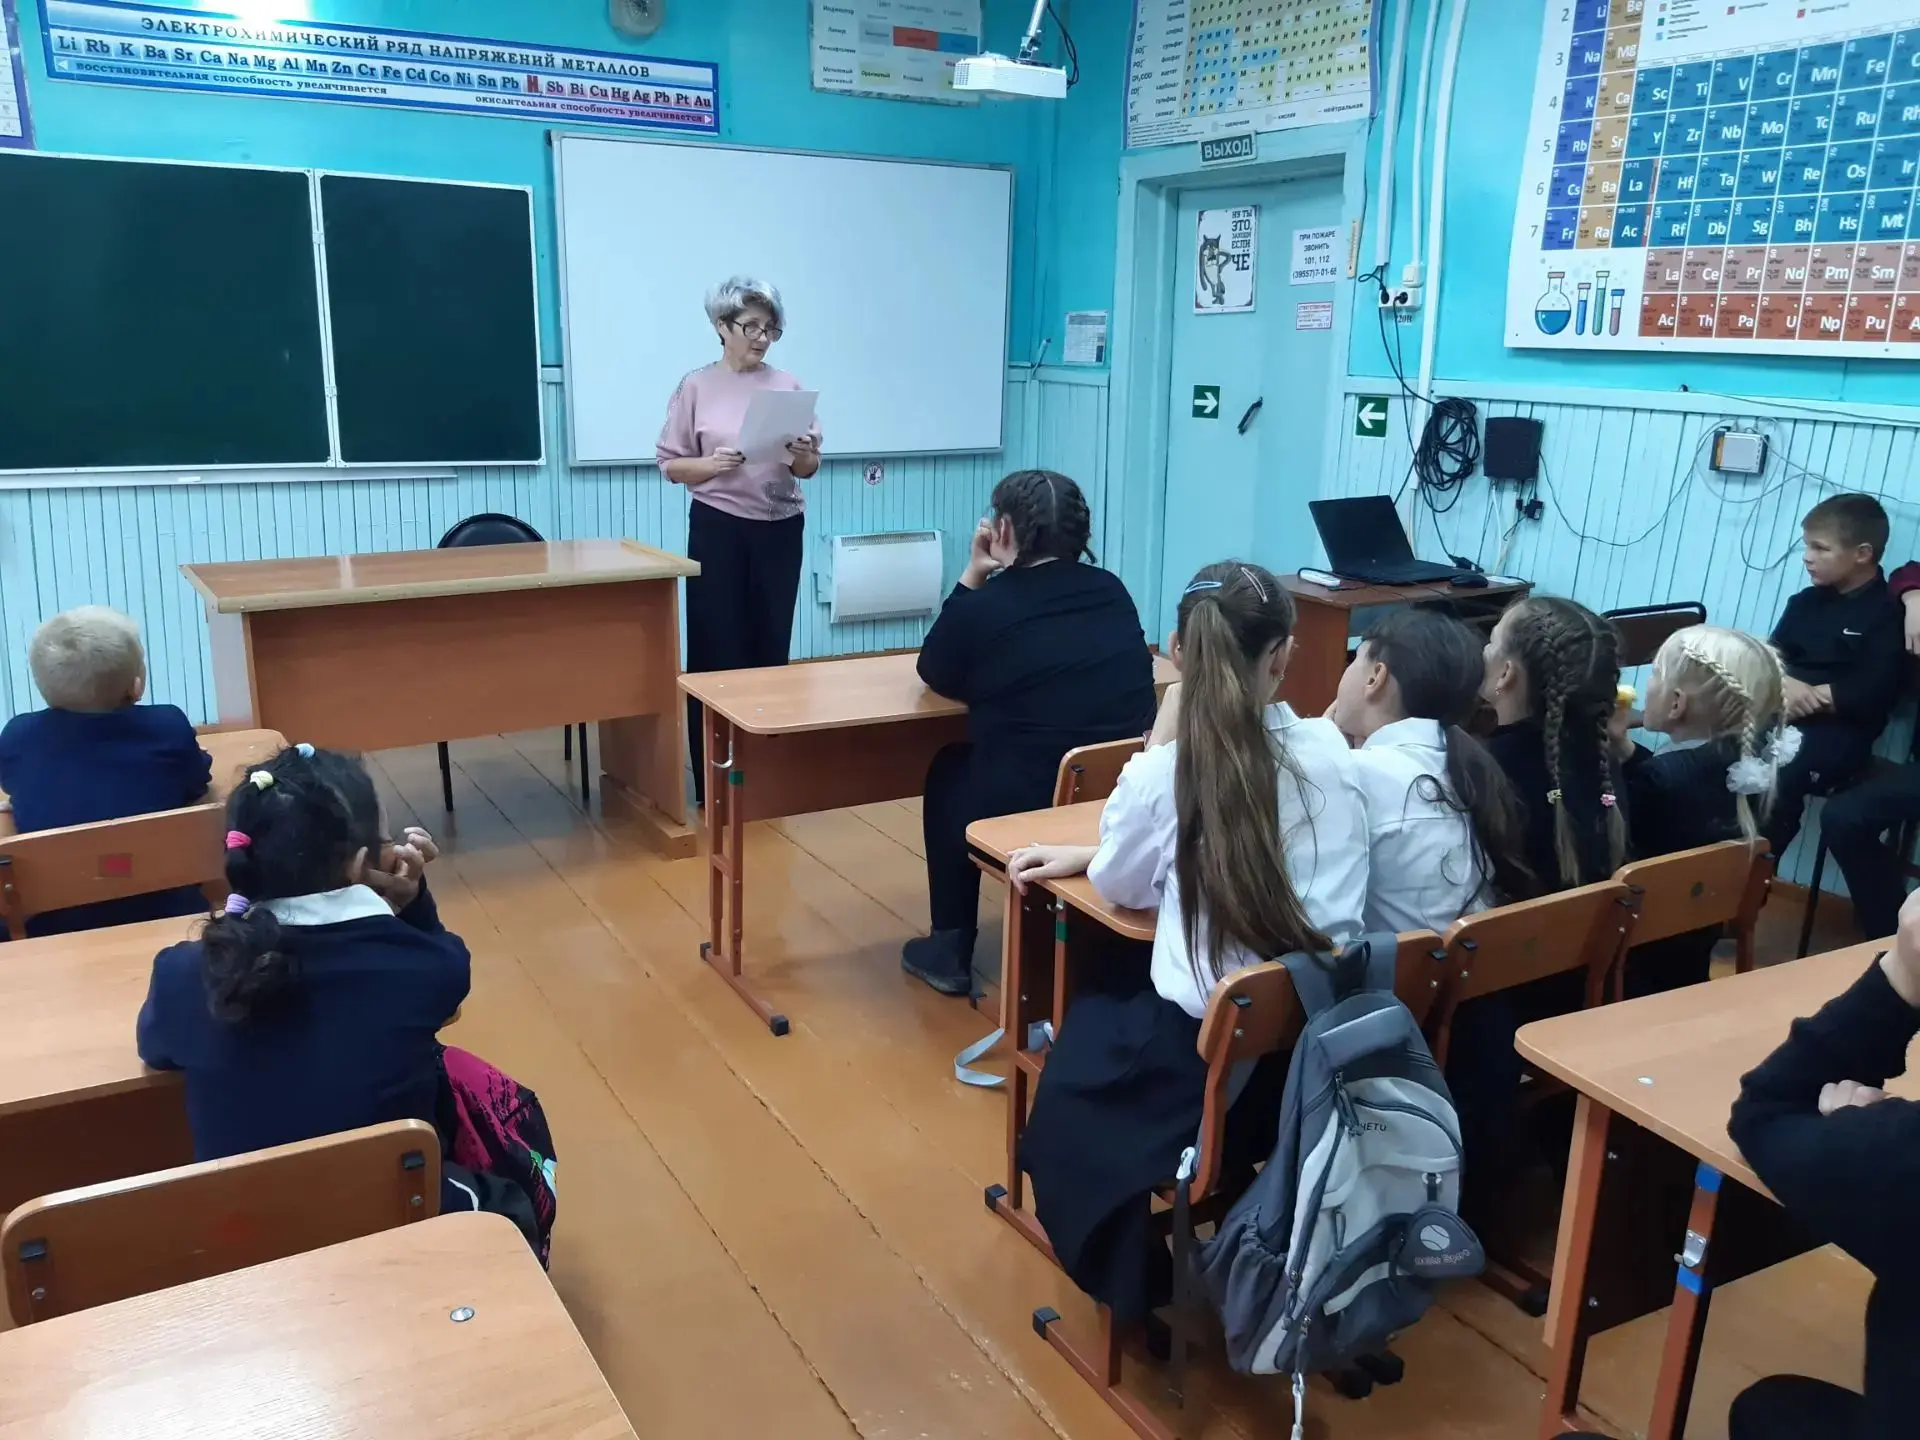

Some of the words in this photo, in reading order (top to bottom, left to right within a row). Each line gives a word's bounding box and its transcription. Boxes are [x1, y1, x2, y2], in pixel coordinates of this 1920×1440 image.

[1597, 5, 1607, 18] Li
[1627, 0, 1642, 13] Be
[1561, 8, 1570, 21] 2
[141, 17, 379, 51] ЭЛЕКТРОХИМИЧЕСКИЙ
[386, 40, 423, 56] РЯД
[429, 45, 555, 69] НАПРЯЖЕНИЙ
[562, 58, 650, 78] МЕТАЛЛОВ
[1555, 52, 1563, 66] 3
[1584, 51, 1600, 63] Na
[58, 36, 77, 50] Li
[85, 39, 110, 54] Rb
[120, 43, 135, 56] K
[144, 45, 168, 60] Ba
[174, 48, 193, 61] Sr
[200, 50, 222, 64] Ca
[227, 52, 249, 66] Na
[253, 55, 277, 71] Mg
[283, 58, 299, 70] Al
[305, 59, 328, 73] Mn
[332, 61, 353, 74] Zn
[357, 63, 377, 77] Cr
[382, 65, 401, 78] Fe
[406, 68, 427, 81] Cd
[430, 70, 450, 83] Co
[456, 72, 472, 85] Ni
[478, 75, 496, 88] Sn
[502, 76, 519, 89] Pb
[546, 81, 564, 94] Sb
[570, 83, 584, 96] Bi
[590, 85, 608, 98] Cu
[611, 87, 630, 102] Hg
[633, 91, 650, 106] Ag
[654, 91, 670, 104] Pb
[676, 93, 689, 106] Pt
[694, 96, 711, 108] Au
[1866, 59, 1885, 74] Fe
[75, 62, 209, 81] восстановительная
[213, 74, 293, 87] способность
[297, 80, 388, 95] увеличивается
[1776, 72, 1792, 85] Cr
[1811, 67, 1837, 82] Mn
[1696, 83, 1708, 96] Ti
[1739, 77, 1749, 90] V
[1615, 92, 1630, 104] Ca
[1652, 87, 1668, 100] Sc
[475, 96, 557, 109] окислительная
[560, 102, 625, 116] способность
[1549, 96, 1557, 108] 4
[1586, 95, 1594, 108] K
[1815, 116, 1829, 129] Tc
[1856, 112, 1876, 126] Ru
[1721, 126, 1741, 139] Nb
[1761, 122, 1783, 134] Mo
[1653, 132, 1662, 144] Y
[1686, 128, 1700, 142] Zr
[1204, 138, 1251, 159] ВЫХОД
[1543, 139, 1550, 152] 5
[1572, 139, 1587, 152] Rb
[1611, 136, 1624, 148] Sr
[1847, 165, 1866, 178] Os
[1902, 160, 1916, 174] Ir
[1719, 173, 1734, 186] Ta
[1761, 171, 1776, 183] W
[1803, 168, 1820, 180] Re
[1536, 182, 1544, 195] 6
[1602, 181, 1616, 193] Ba
[1629, 180, 1643, 192] La
[1677, 176, 1694, 190] Hf
[1567, 184, 1580, 196] Cs
[1752, 220, 1768, 235] Sg
[1795, 218, 1812, 231] Bh
[1839, 217, 1857, 230] Hs
[1881, 214, 1905, 228] Mt
[1531, 225, 1538, 238] 7
[1562, 228, 1574, 240] Fr
[1594, 227, 1610, 238] Ra
[1621, 225, 1637, 238] Ac
[1671, 223, 1686, 236] Rf
[1708, 222, 1726, 235] Db
[1312, 231, 1336, 240] ПОЖАРЕ
[1231, 239, 1251, 249] ЕСЛИ
[1304, 243, 1330, 252] ЗВОНИТЬ
[1231, 248, 1250, 271] ЧЁ
[1319, 255, 1330, 263] 112
[1665, 268, 1680, 281] La
[1702, 268, 1719, 280] Ce
[1746, 267, 1761, 279] Pr
[1784, 266, 1804, 279] Nd
[1825, 266, 1849, 279] Pm
[1871, 265, 1895, 279] Sm
[1658, 314, 1674, 326] Ac
[1698, 314, 1713, 327] Th
[1738, 315, 1753, 327] Pa
[1786, 315, 1797, 328] U
[1820, 316, 1840, 332] Np
[1865, 315, 1885, 329] Pu
